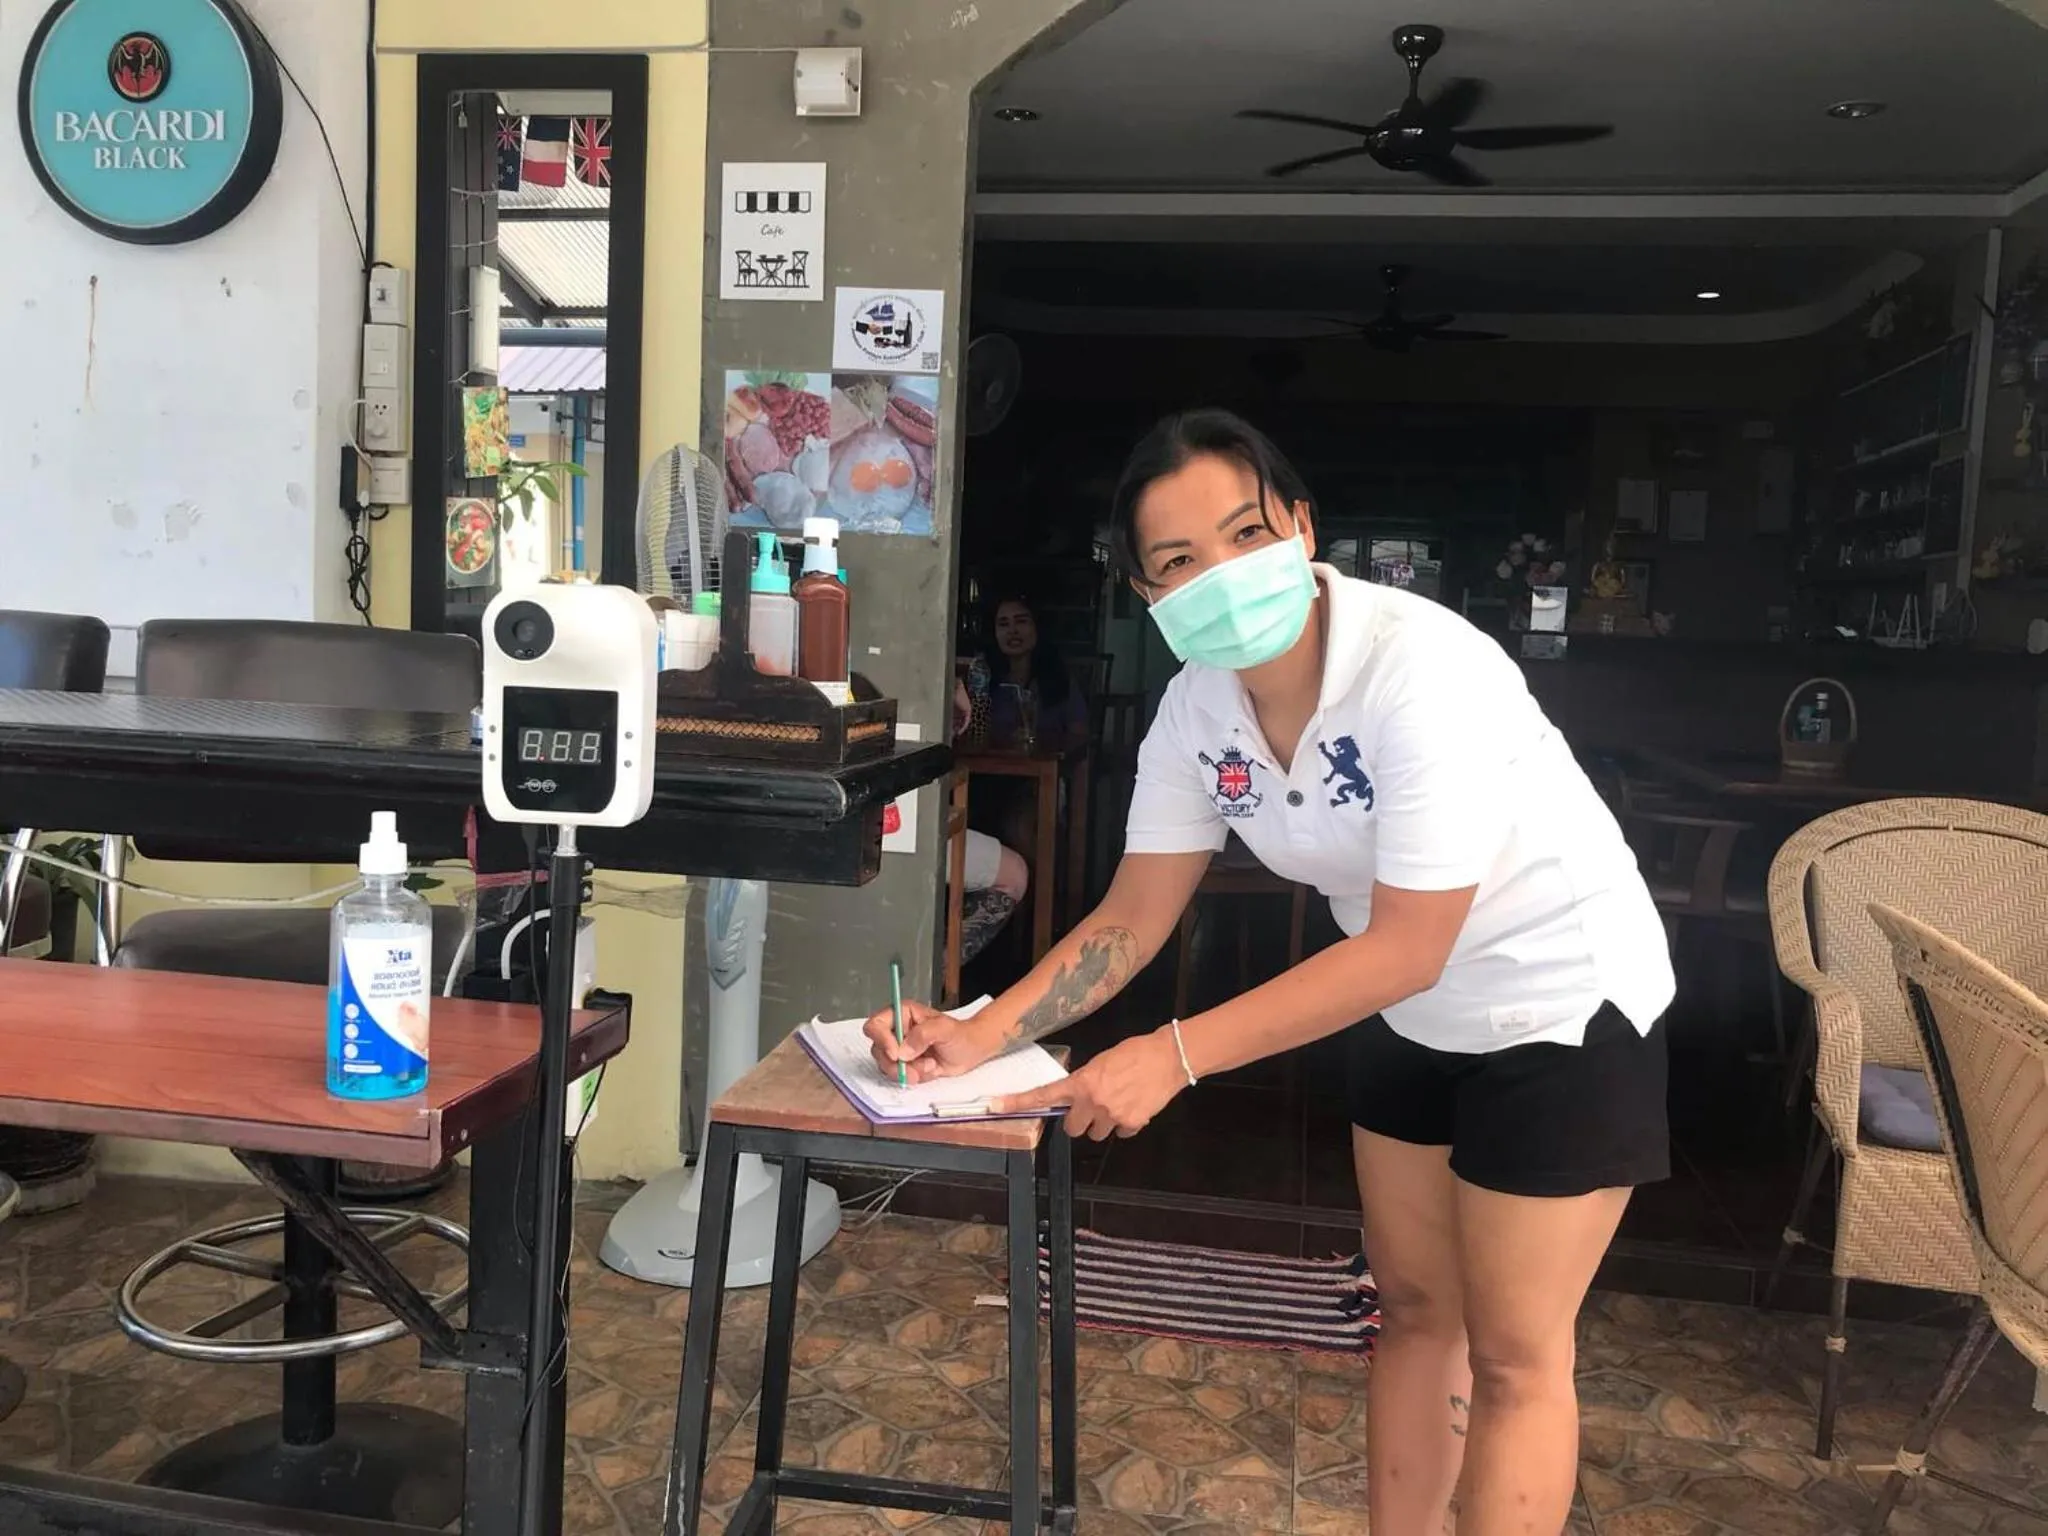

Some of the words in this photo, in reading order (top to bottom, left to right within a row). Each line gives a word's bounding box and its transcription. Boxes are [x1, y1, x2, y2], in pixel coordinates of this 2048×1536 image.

[55, 109, 226, 143] BACARDI
[94, 146, 186, 169] BLACK
[760, 223, 785, 238] Cafe
